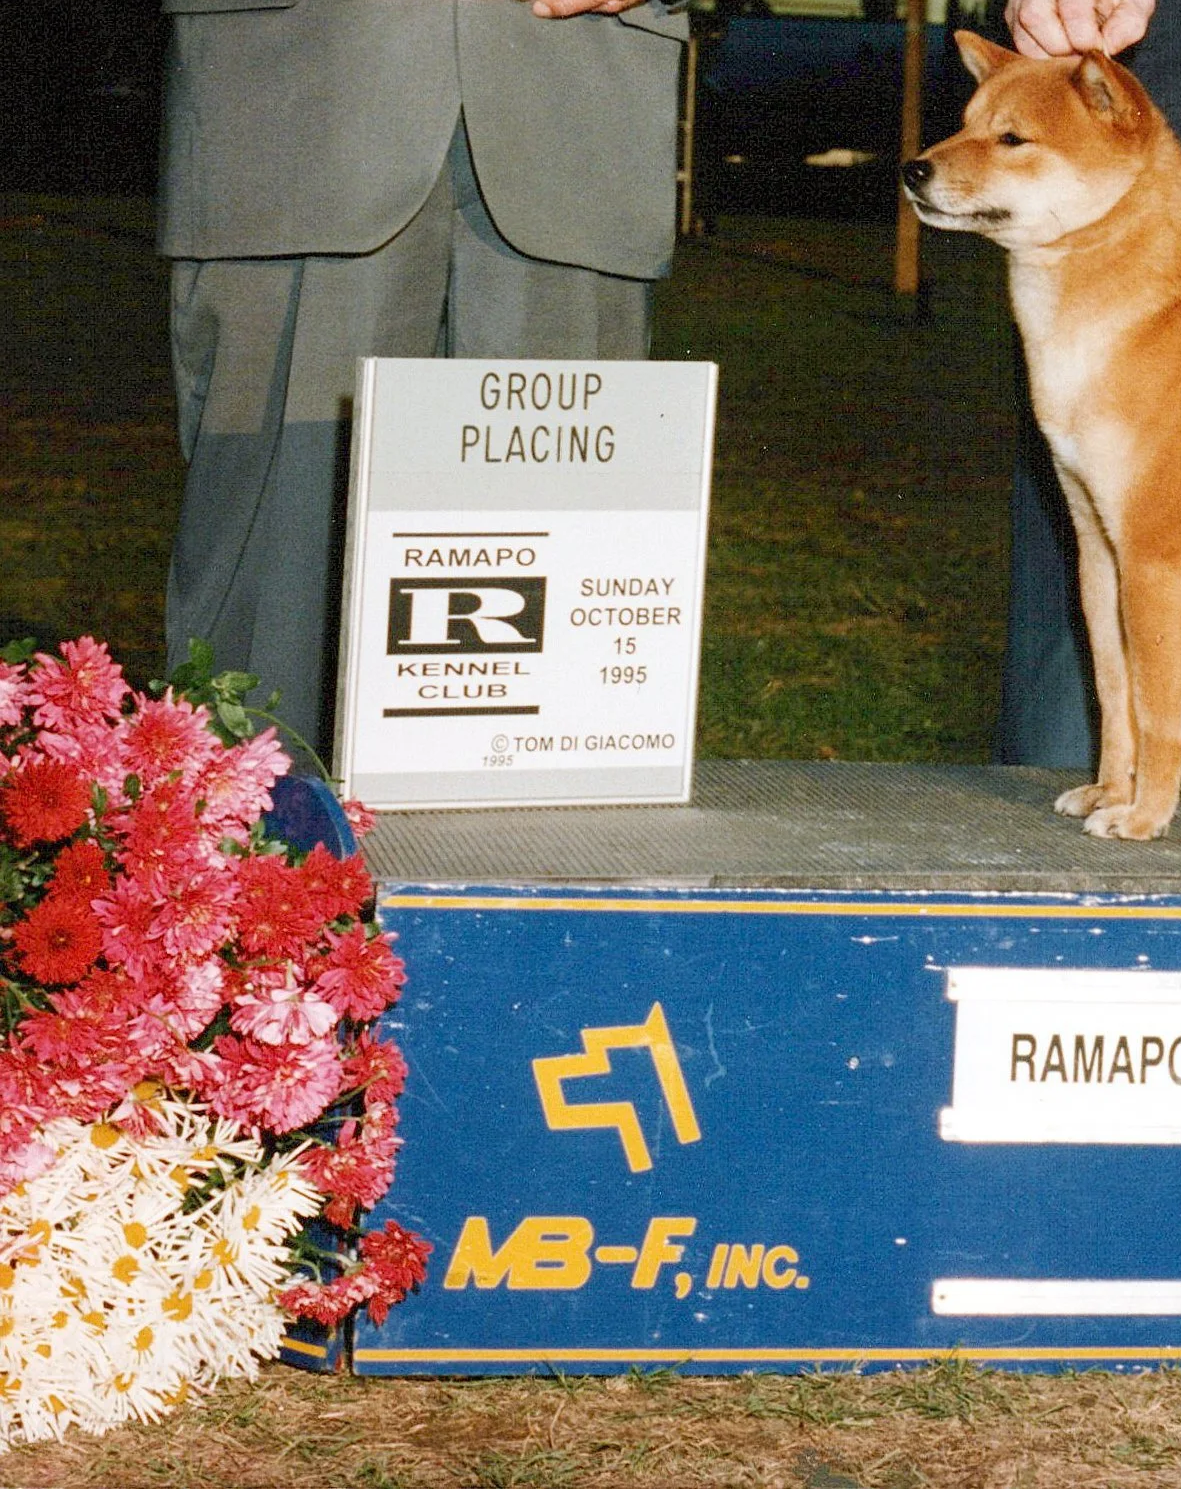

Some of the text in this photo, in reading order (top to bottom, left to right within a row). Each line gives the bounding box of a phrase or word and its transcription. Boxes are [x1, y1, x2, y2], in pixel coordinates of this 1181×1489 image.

[480, 372, 602, 411] GROUP
[461, 425, 615, 463] PLACING
[405, 548, 536, 567] RAMAPO
[581, 578, 674, 597] SUNDAY
[398, 588, 537, 645] R
[571, 607, 681, 626] OCTOBER
[614, 637, 636, 654] 15
[398, 662, 529, 677] KENNEL
[600, 666, 646, 684] 1995
[418, 684, 507, 699] CLUB
[514, 736, 553, 752] TOM
[561, 736, 578, 751] DI
[585, 734, 675, 751] GIACOMO
[482, 755, 514, 767] 1995
[444, 1217, 808, 1298] MB-F, INC.
